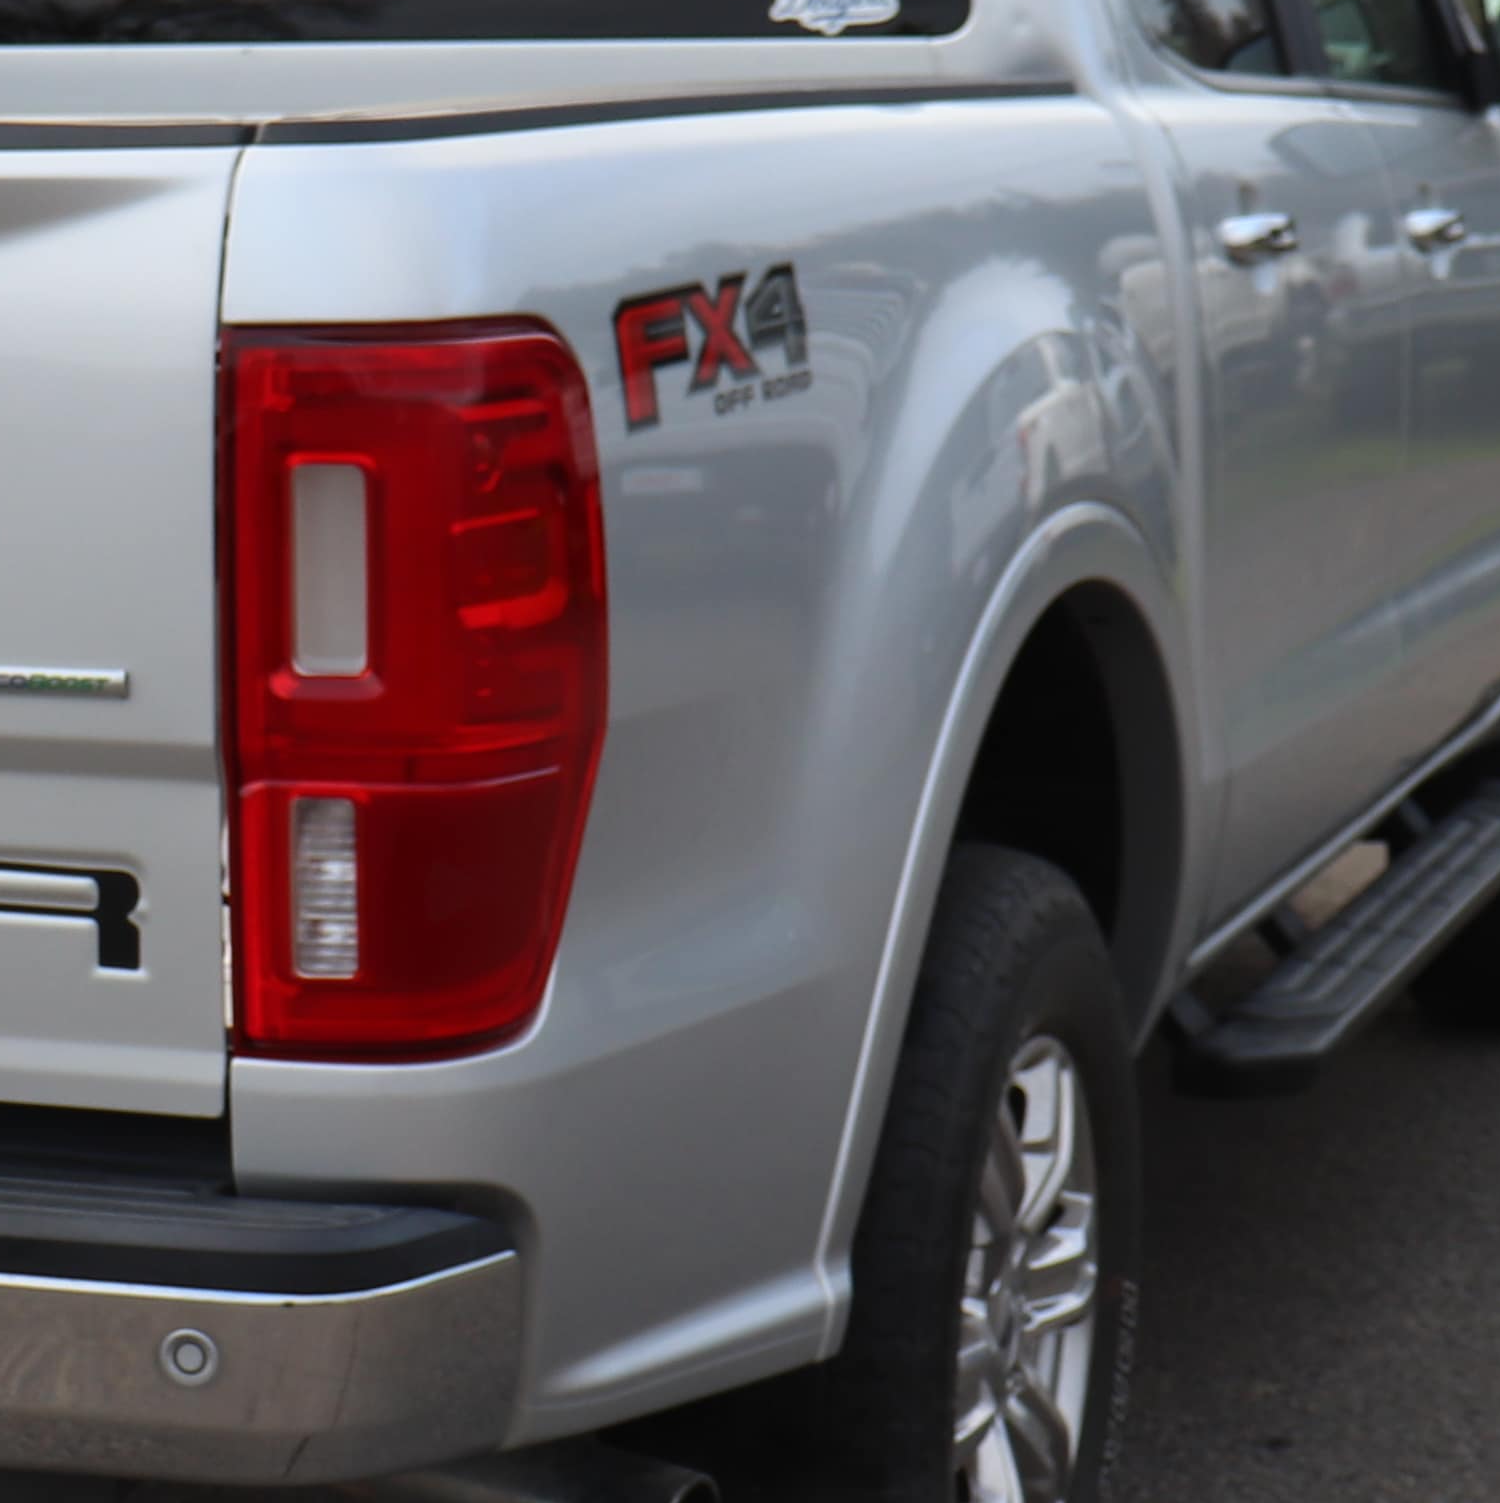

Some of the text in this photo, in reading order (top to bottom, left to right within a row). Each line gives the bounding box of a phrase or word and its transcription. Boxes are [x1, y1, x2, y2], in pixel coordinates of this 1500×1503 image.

[612, 259, 809, 436] FX4
[713, 370, 813, 416] OFF ROAD
